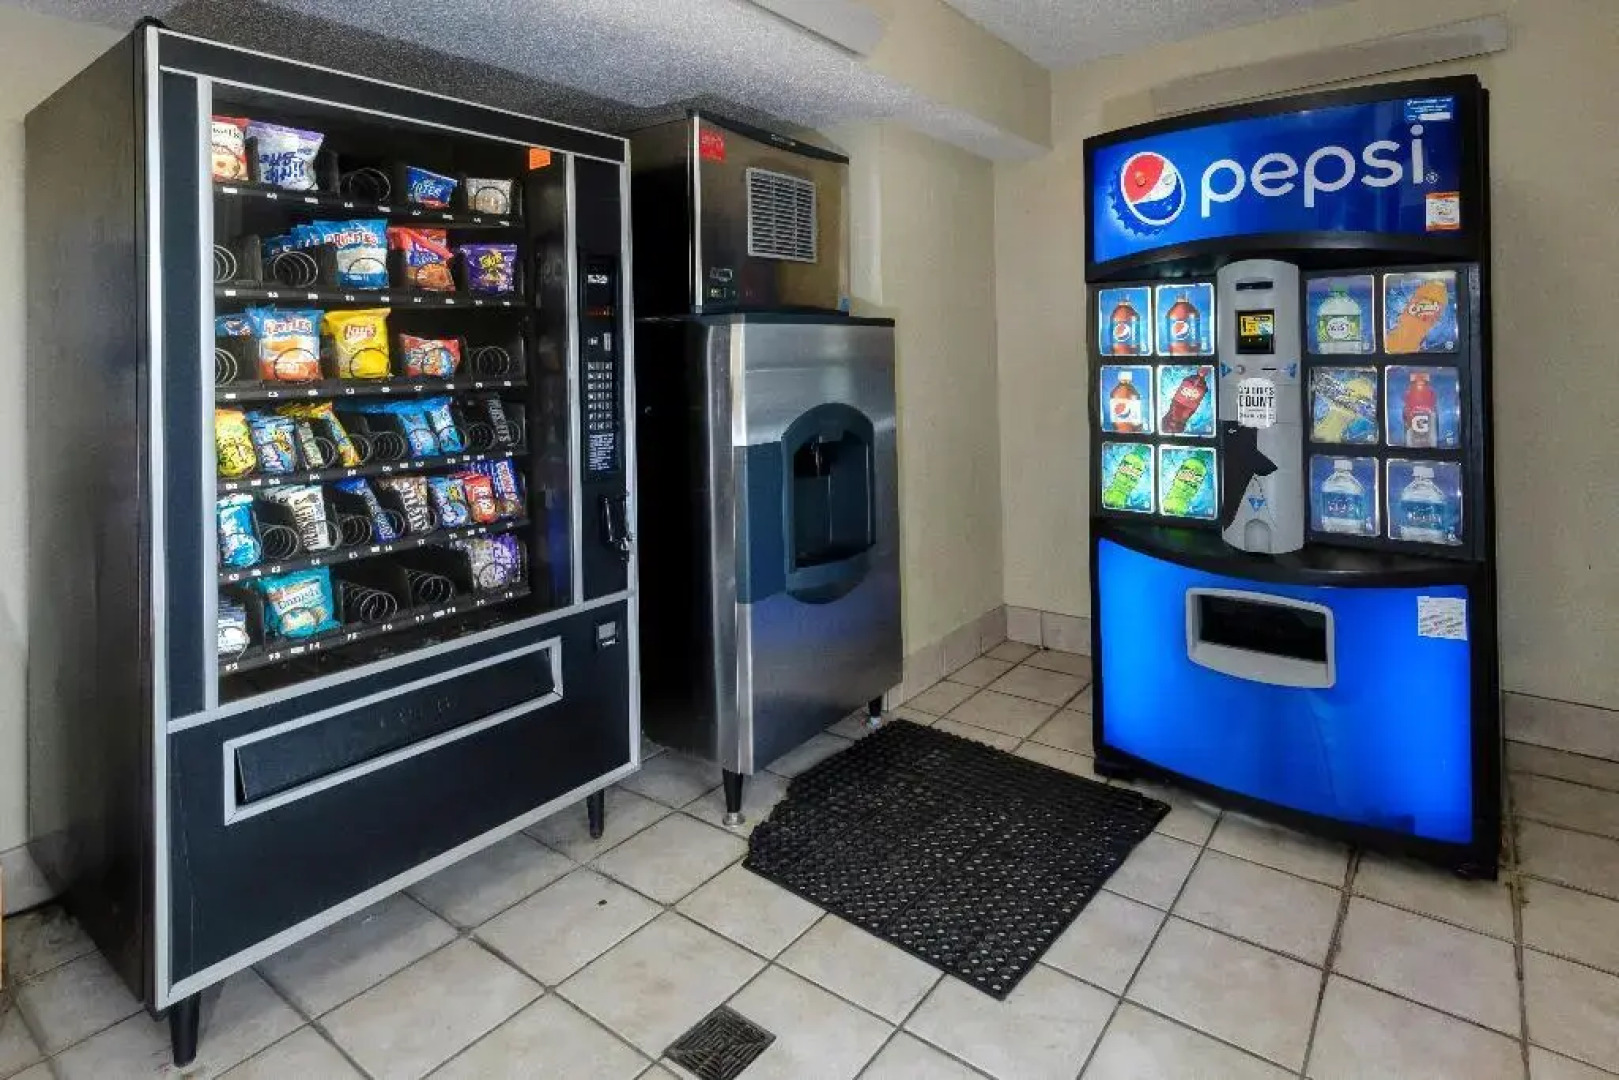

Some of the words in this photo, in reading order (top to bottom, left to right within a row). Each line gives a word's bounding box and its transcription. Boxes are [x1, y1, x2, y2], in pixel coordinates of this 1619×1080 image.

[1201, 124, 1425, 218] pepsi
[1239, 395, 1274, 407] COUNT
[1411, 415, 1430, 432] G
